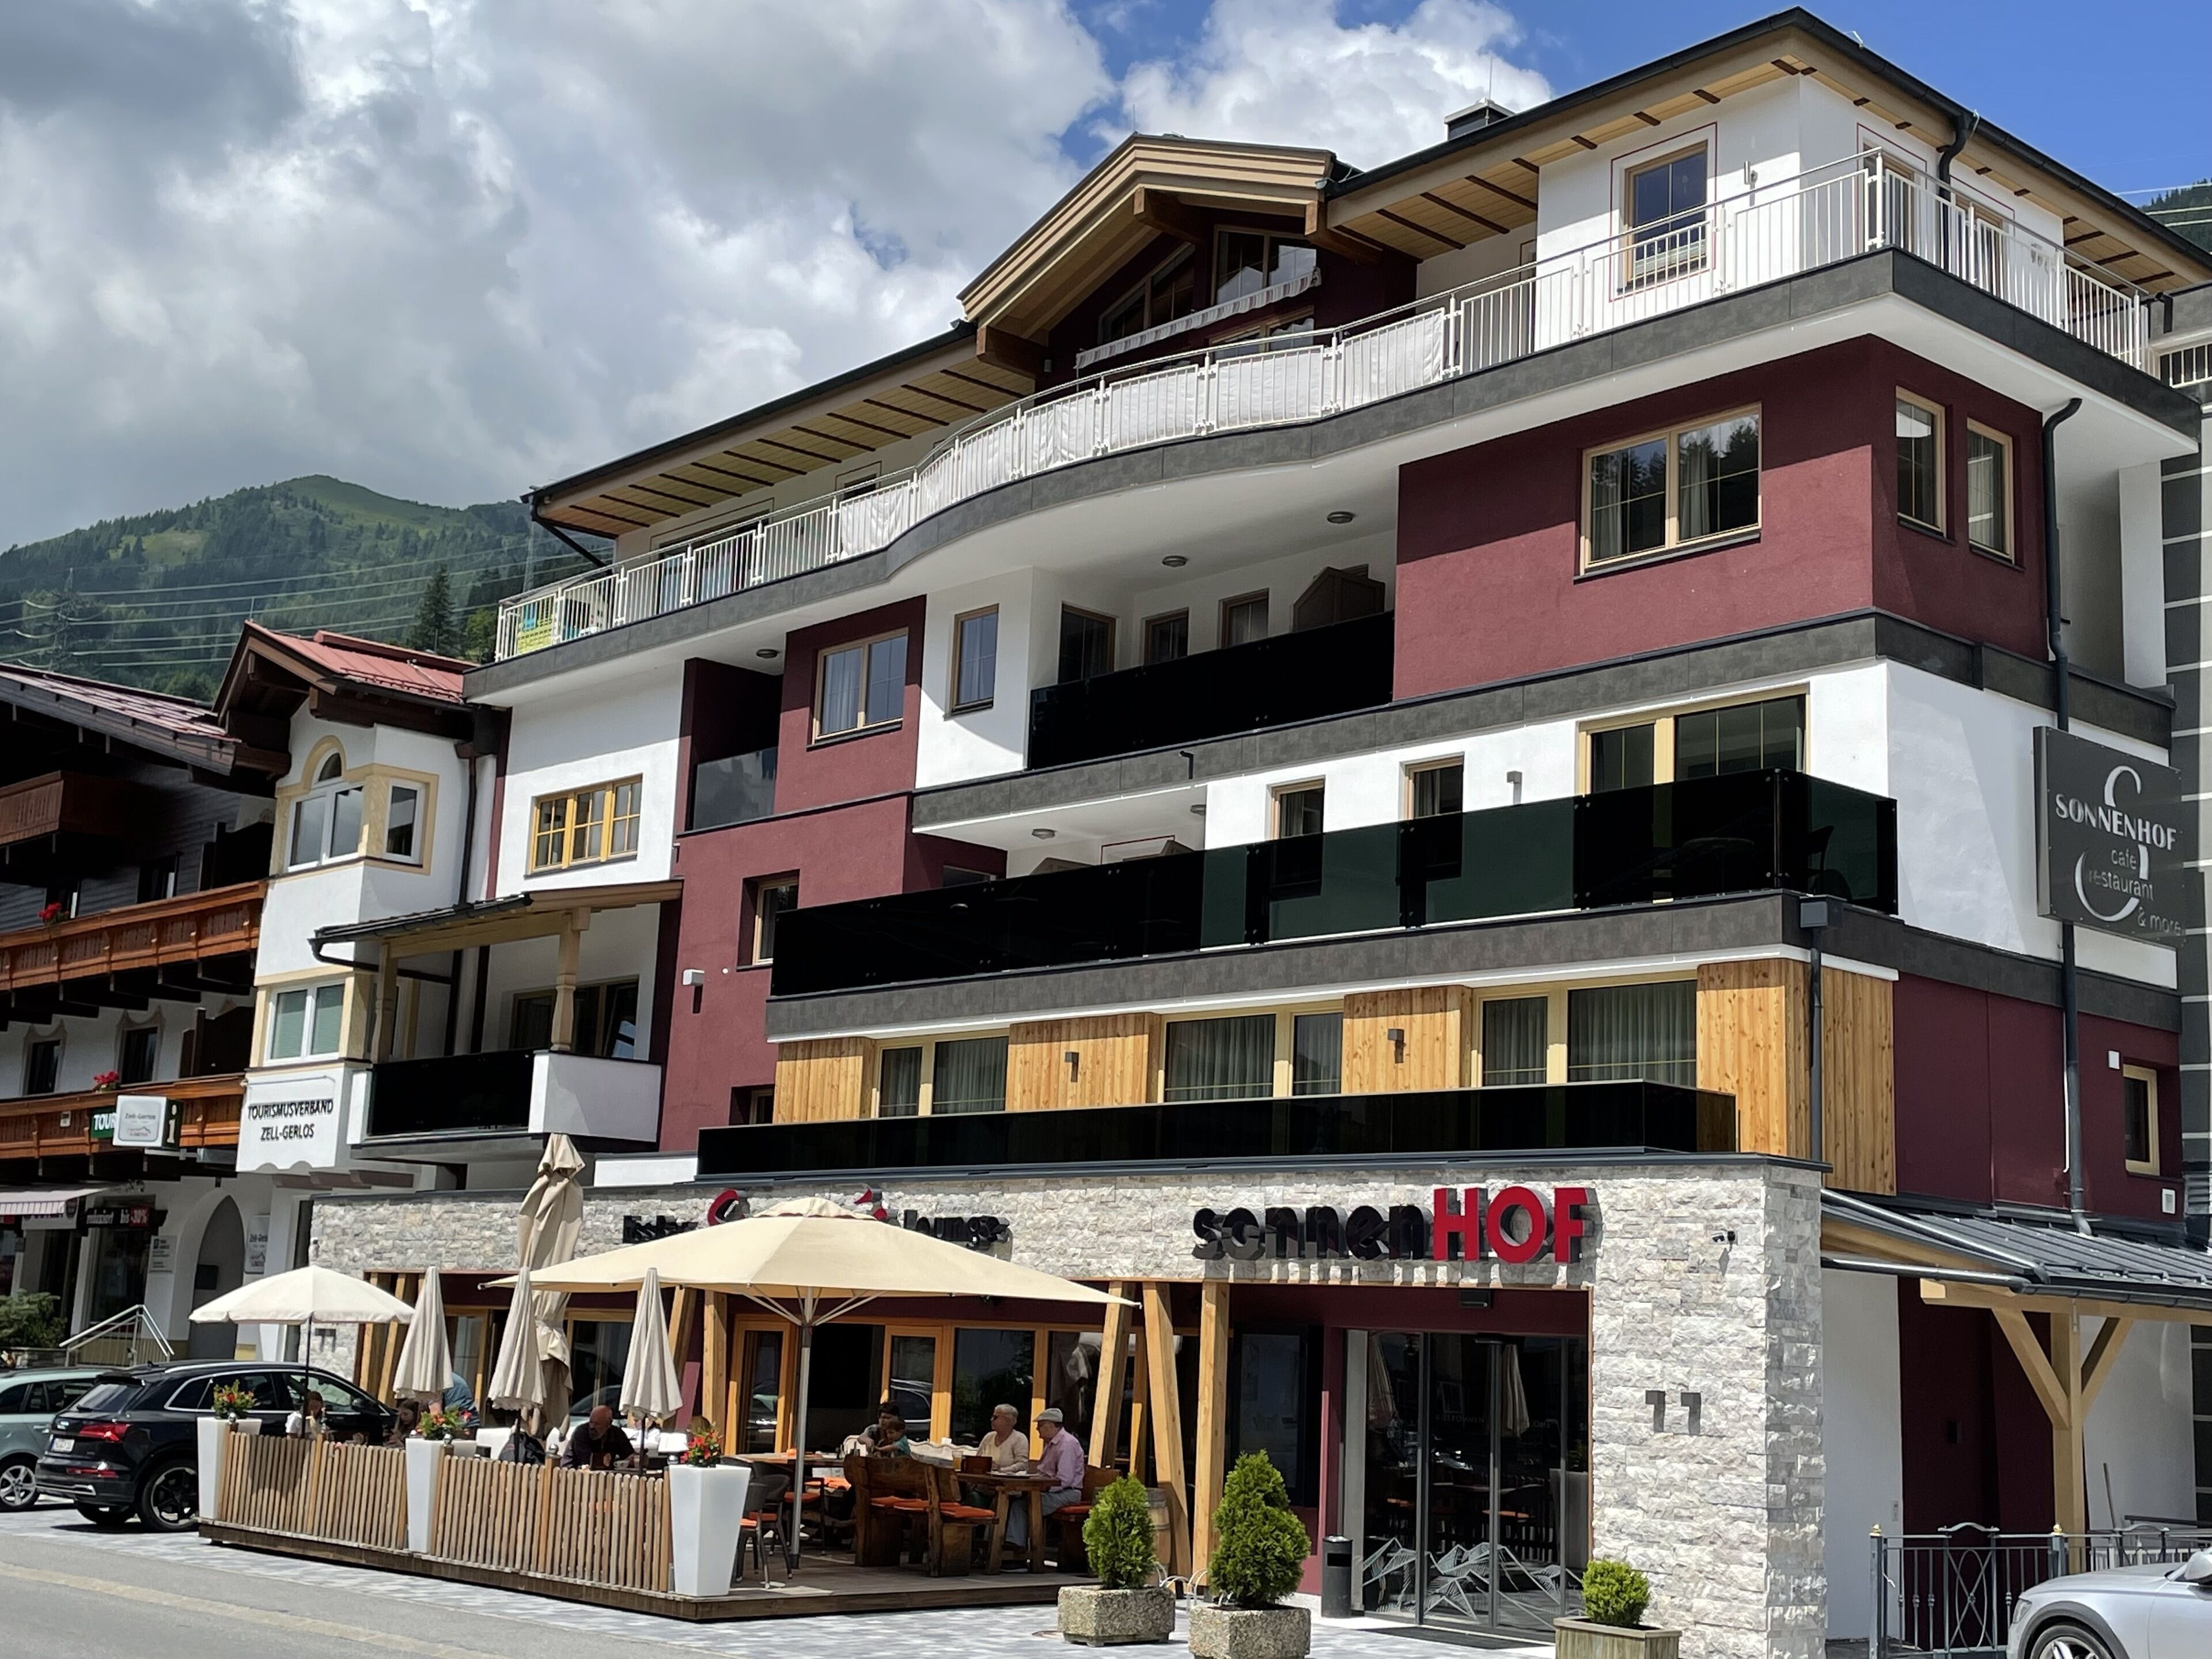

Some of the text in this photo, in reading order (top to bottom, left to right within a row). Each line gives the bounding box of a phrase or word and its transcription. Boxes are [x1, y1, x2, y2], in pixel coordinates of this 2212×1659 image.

[2055, 793, 2177, 851] SONNENHOF
[2088, 868, 2154, 901] restaurant
[2149, 914, 2183, 937] more
[248, 1099, 334, 1120] TOURISMUSVERBAND
[260, 1123, 315, 1142] ZELL-GERLOS
